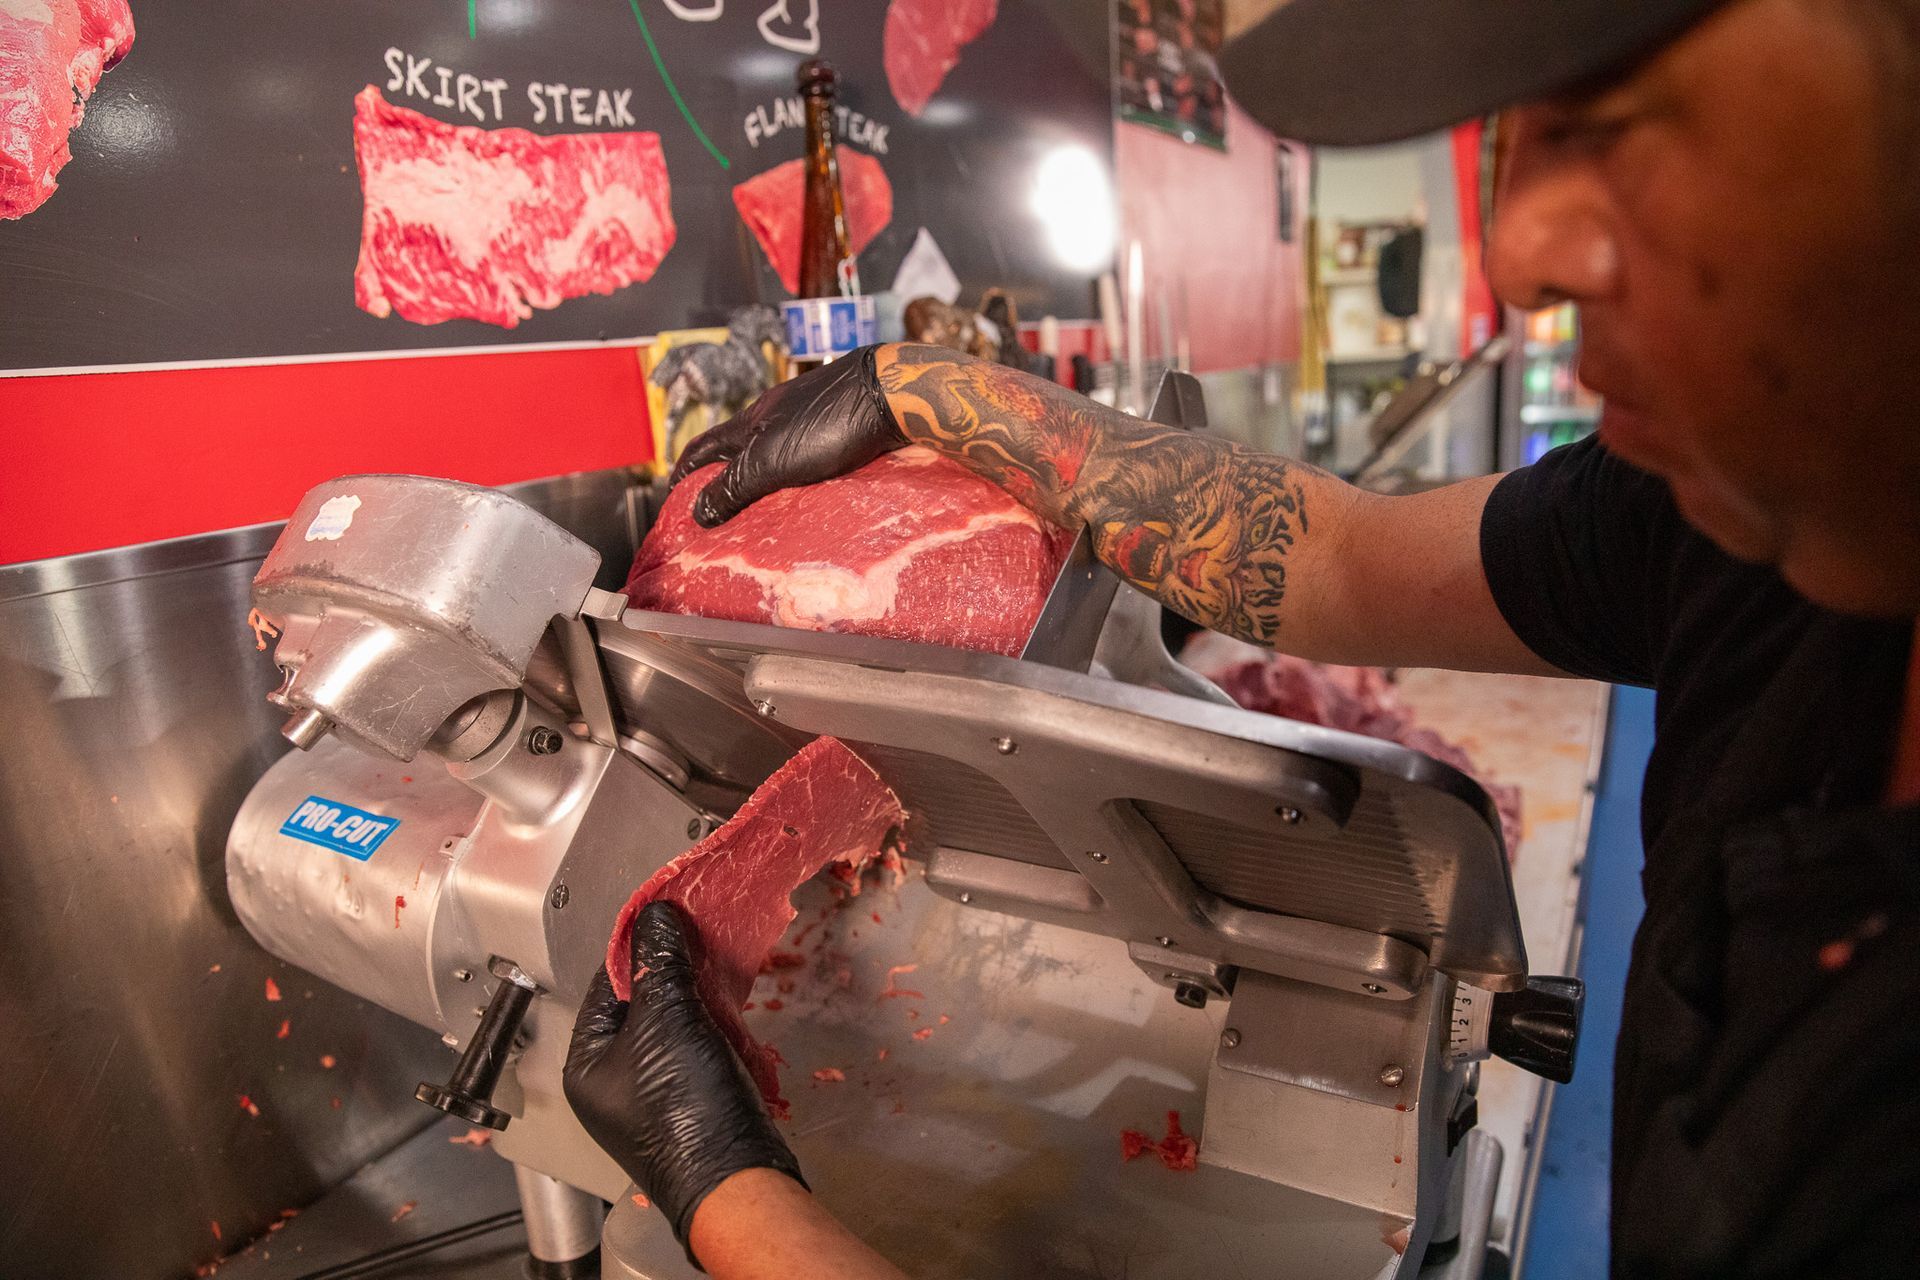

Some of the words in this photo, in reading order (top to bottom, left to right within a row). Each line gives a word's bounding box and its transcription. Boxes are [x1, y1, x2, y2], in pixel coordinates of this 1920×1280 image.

[384, 47, 508, 122] SKIRT
[528, 82, 635, 127] STEAK
[744, 96, 806, 148] FLAN
[833, 104, 890, 154] TEAK
[289, 801, 389, 846] PRO-CUT
[1458, 1018, 1469, 1026] 2
[1461, 997, 1472, 1006] 3
